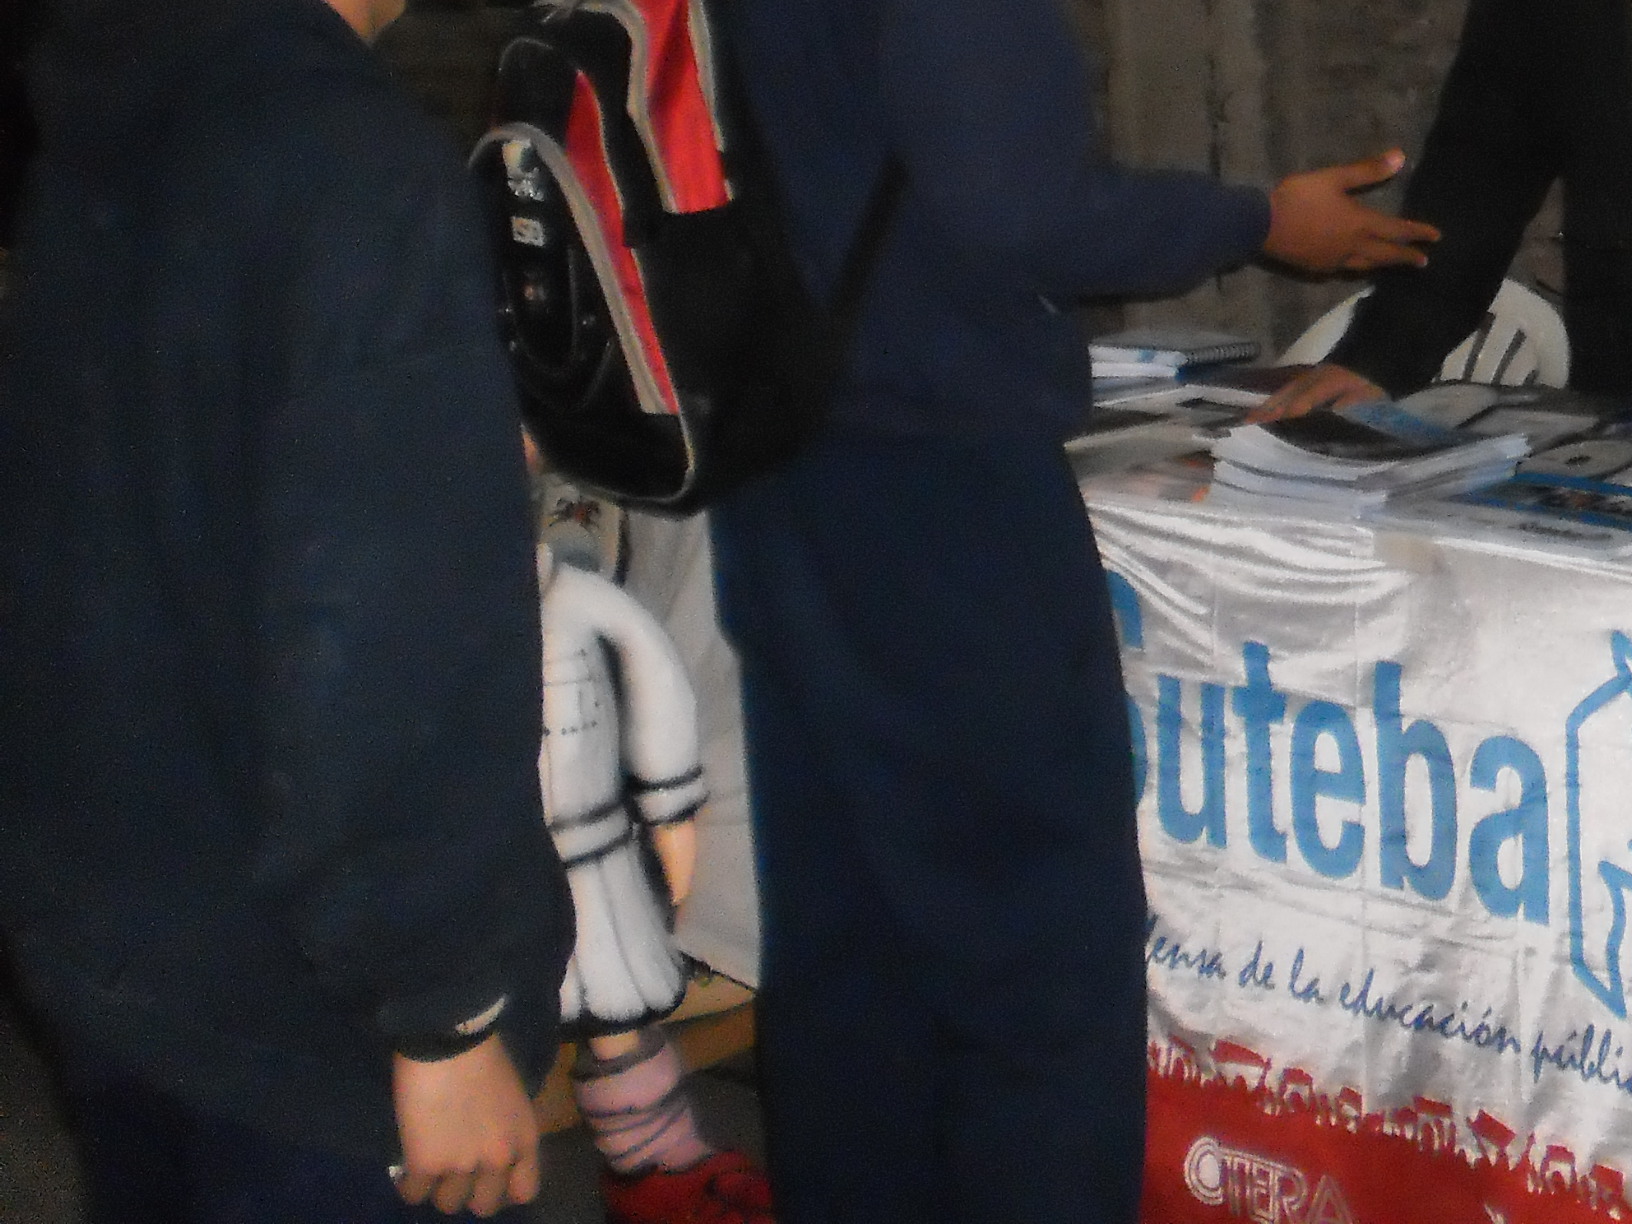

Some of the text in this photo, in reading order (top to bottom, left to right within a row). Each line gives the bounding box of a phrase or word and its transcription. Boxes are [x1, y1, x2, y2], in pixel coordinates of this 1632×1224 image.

[1146, 924, 1227, 980] ensa
[1238, 940, 1277, 991] de
[1288, 948, 1326, 1004] la
[1339, 969, 1523, 1055] educación
[1184, 1135, 1356, 1224] CTERA
